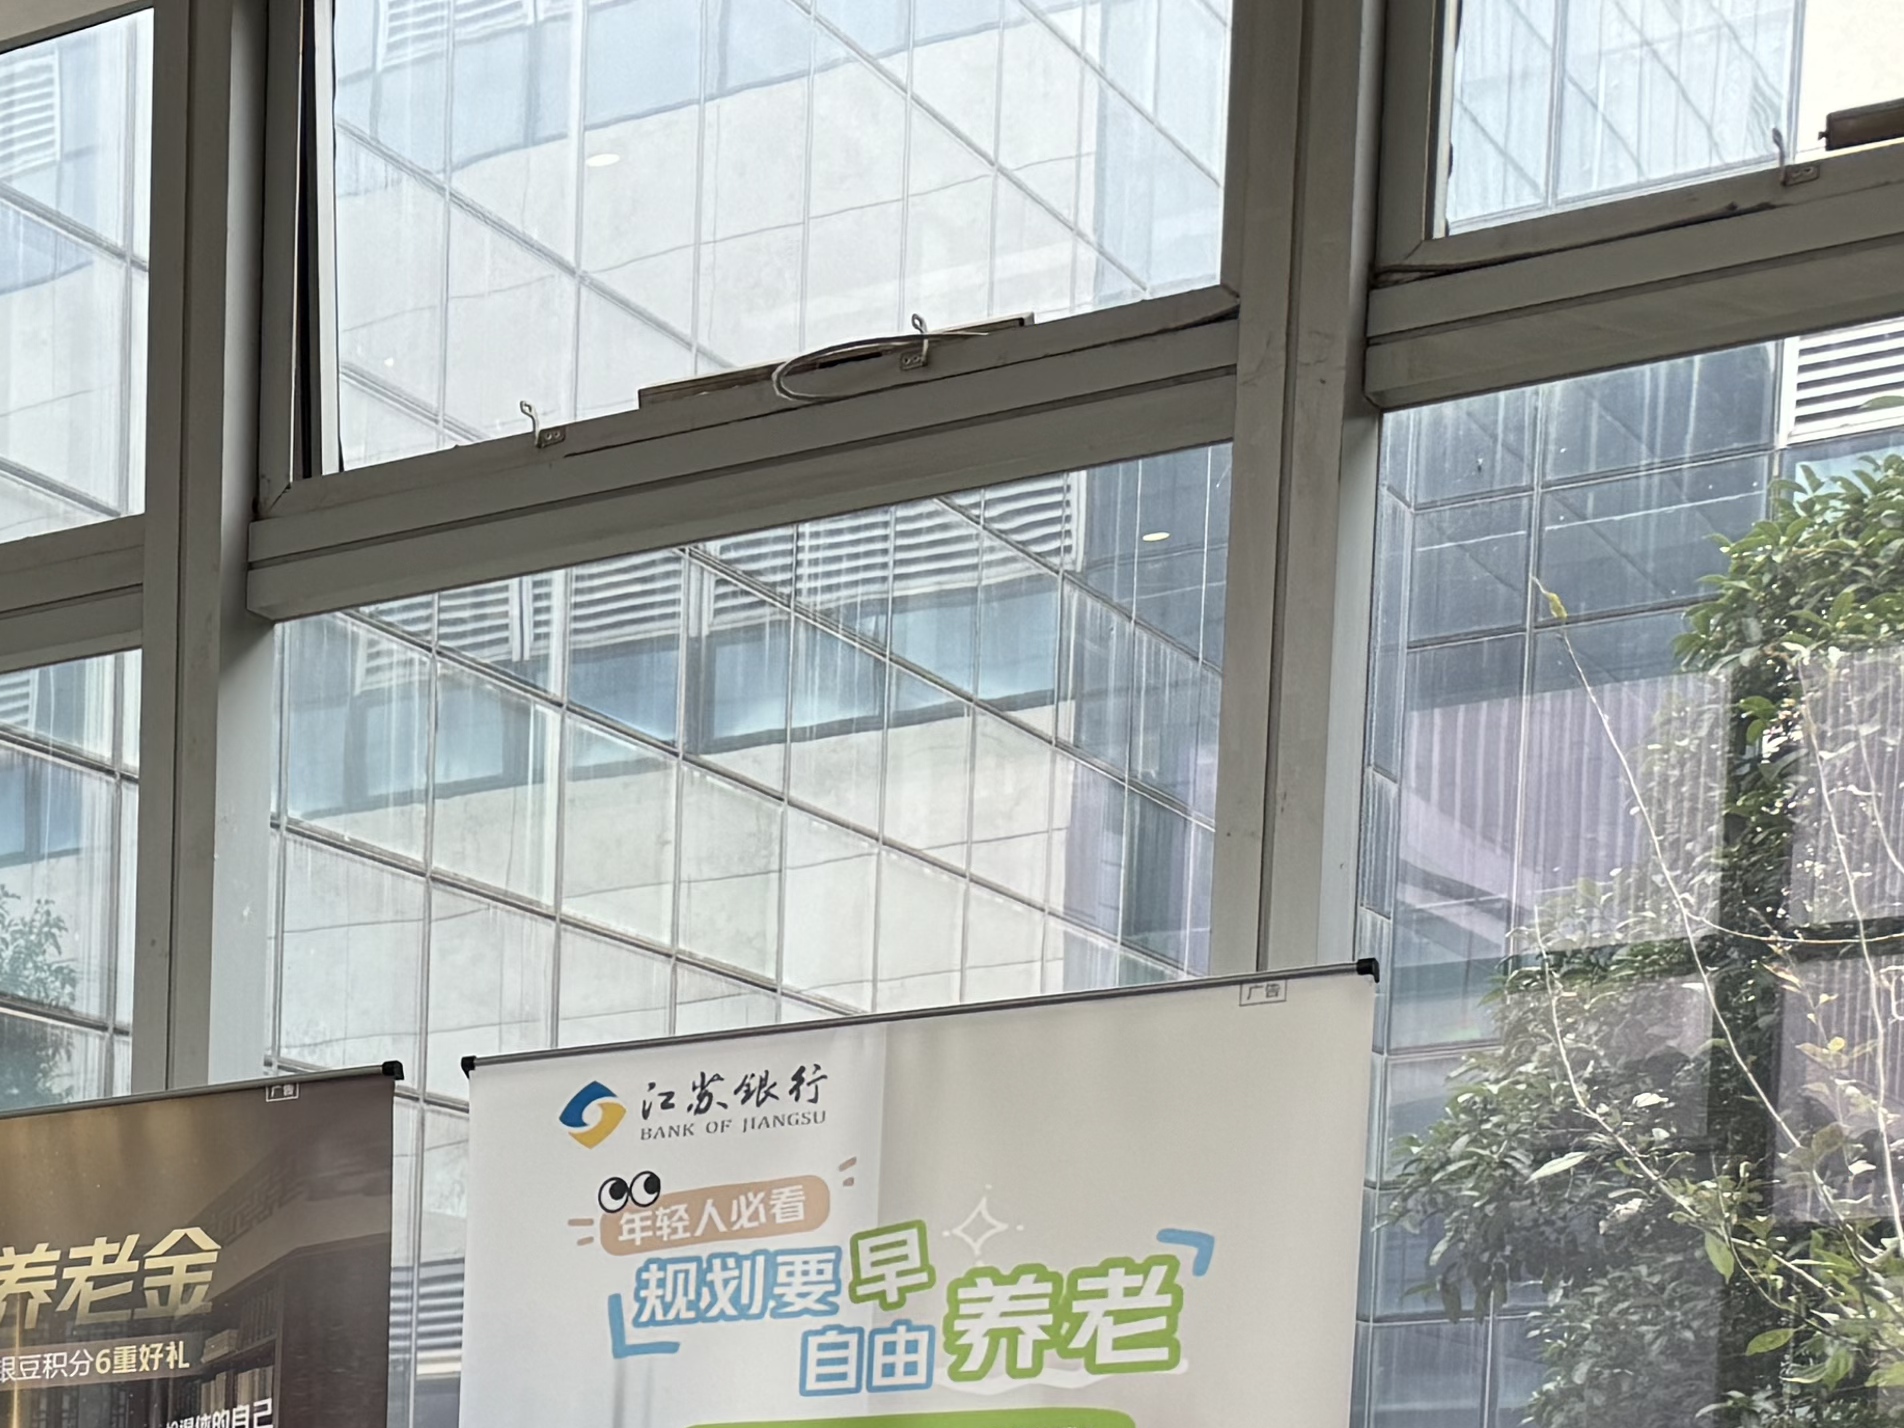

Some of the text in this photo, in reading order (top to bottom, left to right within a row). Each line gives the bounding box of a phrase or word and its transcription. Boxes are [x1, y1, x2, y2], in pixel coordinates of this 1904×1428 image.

[641, 1063, 828, 1121] 江苏银行
[640, 1110, 827, 1141] BANK OF JIANGSU
[617, 1184, 807, 1247] 年轻人必看
